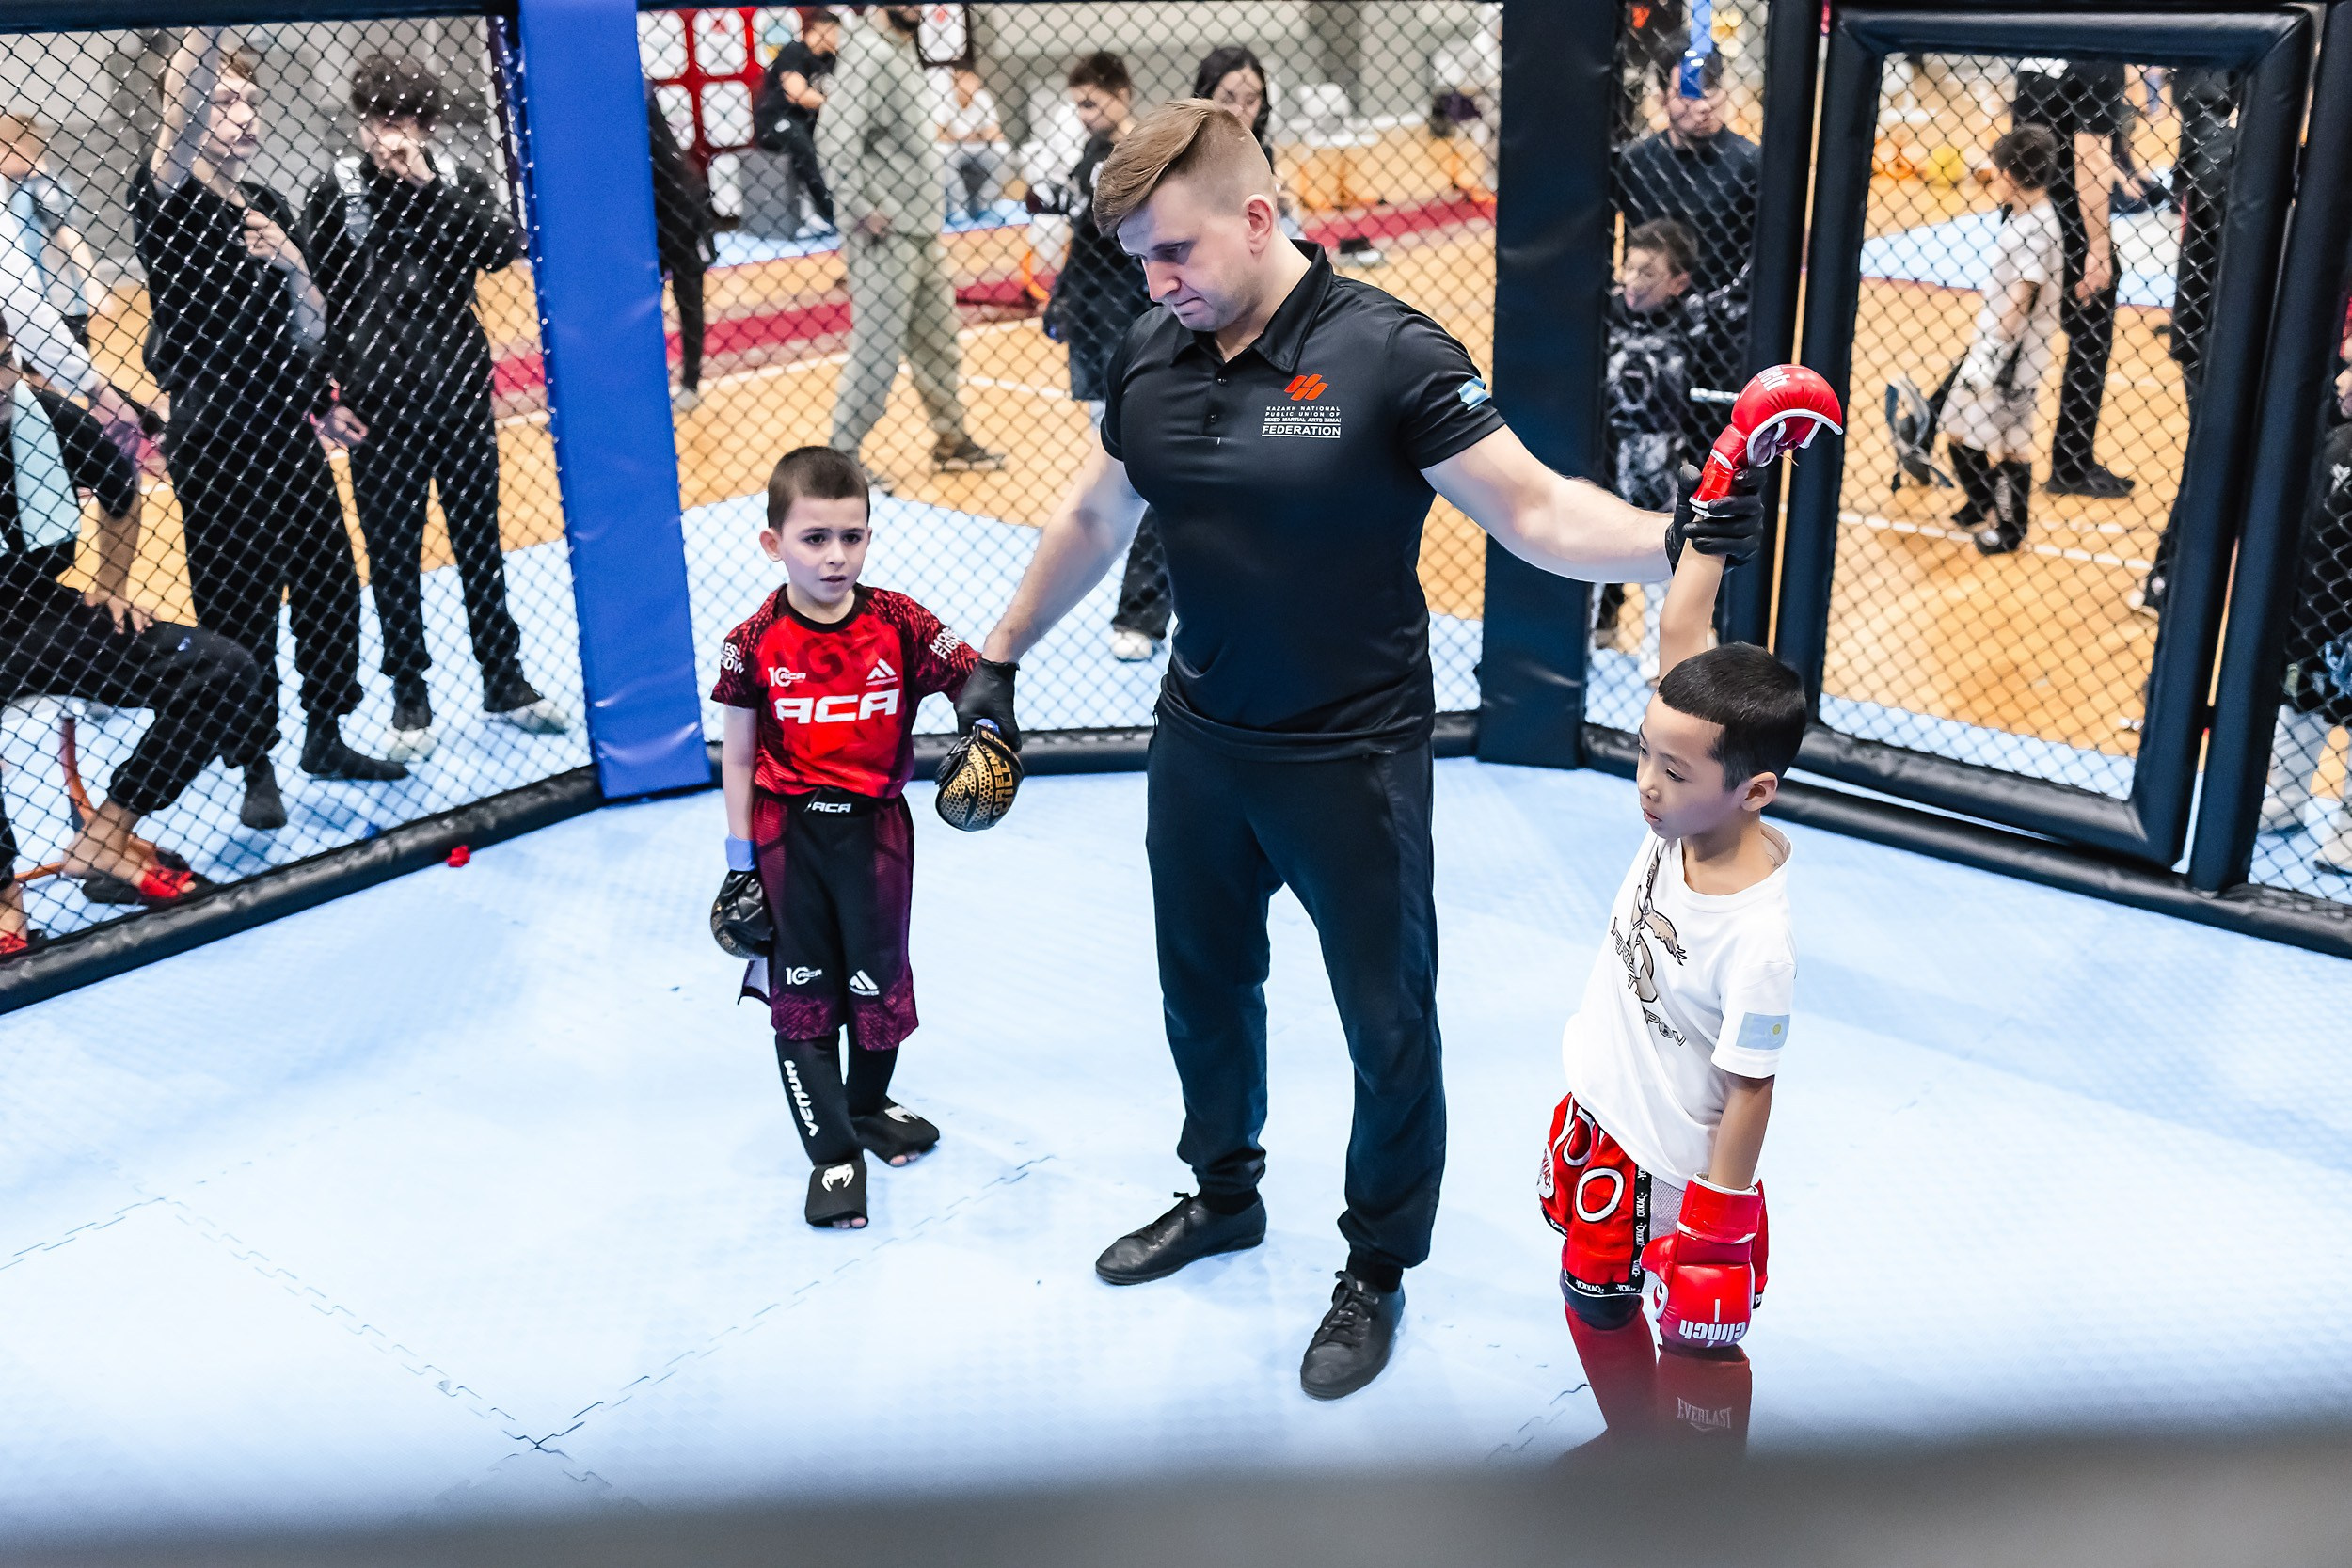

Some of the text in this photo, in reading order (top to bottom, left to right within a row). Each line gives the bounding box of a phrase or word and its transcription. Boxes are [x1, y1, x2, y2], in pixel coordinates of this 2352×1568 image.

[1262, 425, 1342, 436] FEDERATION
[774, 689, 899, 724] ACA
[811, 801, 852, 813] ACA
[784, 1059, 819, 1137] VENUM
[1678, 1319, 1747, 1343] clinch
[1677, 1396, 1733, 1429] EVERLAST
